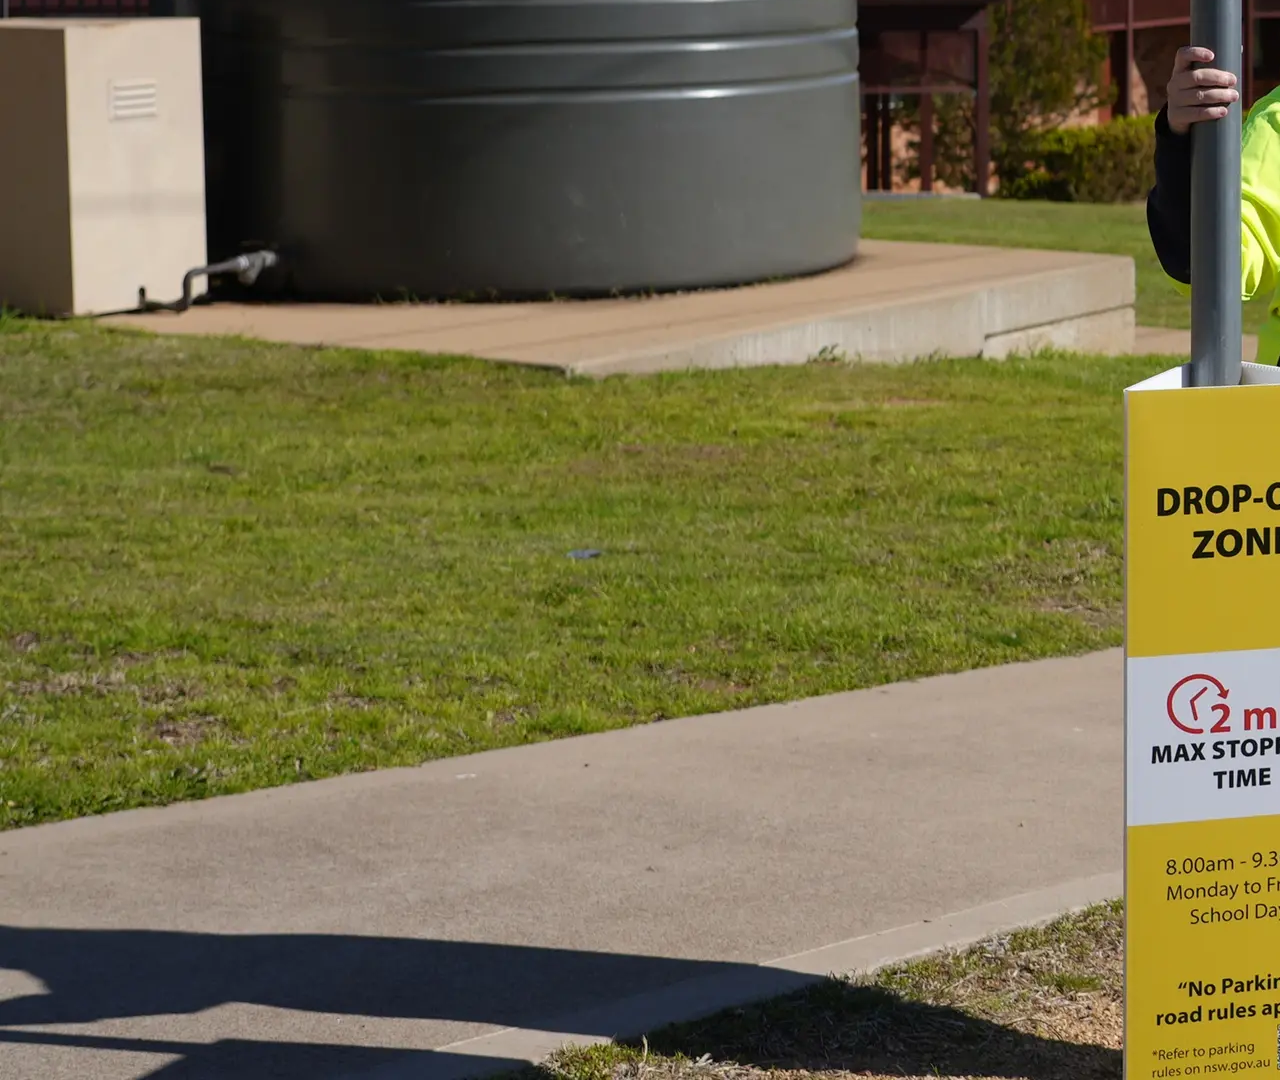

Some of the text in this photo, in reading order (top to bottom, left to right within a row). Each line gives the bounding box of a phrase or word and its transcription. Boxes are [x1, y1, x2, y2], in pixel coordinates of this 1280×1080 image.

[1209, 703, 1231, 734] 2
[1151, 742, 1206, 764] MAX
[1213, 767, 1271, 790] TIME
[1165, 856, 1234, 876] 8.00am
[1166, 880, 1239, 901] Monday
[1243, 879, 1262, 894] to
[1190, 904, 1249, 925] School
[1156, 1006, 1202, 1026] road
[1208, 1002, 1256, 1021] rules
[1193, 1047, 1206, 1057] to
[1208, 1042, 1255, 1058] parking
[1152, 1059, 1271, 1078] rules on nsw.gov.au
